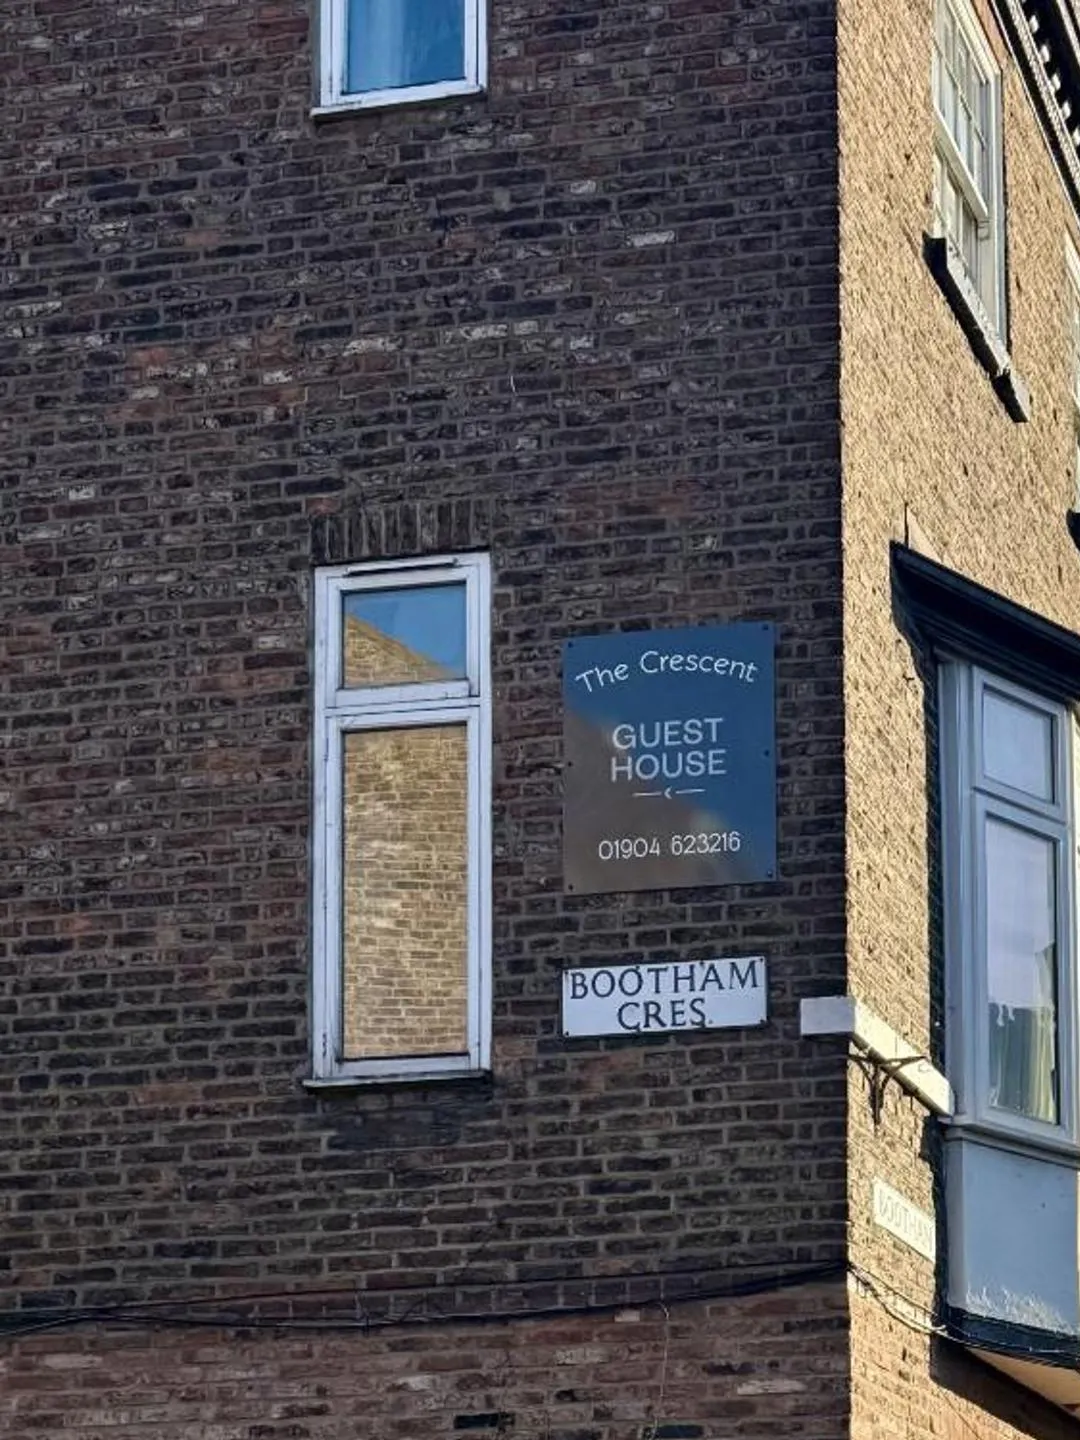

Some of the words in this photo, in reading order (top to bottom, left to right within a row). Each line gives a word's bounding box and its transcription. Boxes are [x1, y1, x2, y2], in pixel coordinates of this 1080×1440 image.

[575, 662, 629, 693] The
[639, 650, 759, 684] Crescent
[612, 718, 724, 751] GUEST
[611, 750, 727, 782] HOUSE
[598, 836, 661, 861] 01904
[671, 831, 741, 856] 623216
[570, 962, 759, 1000] BOOTHAM
